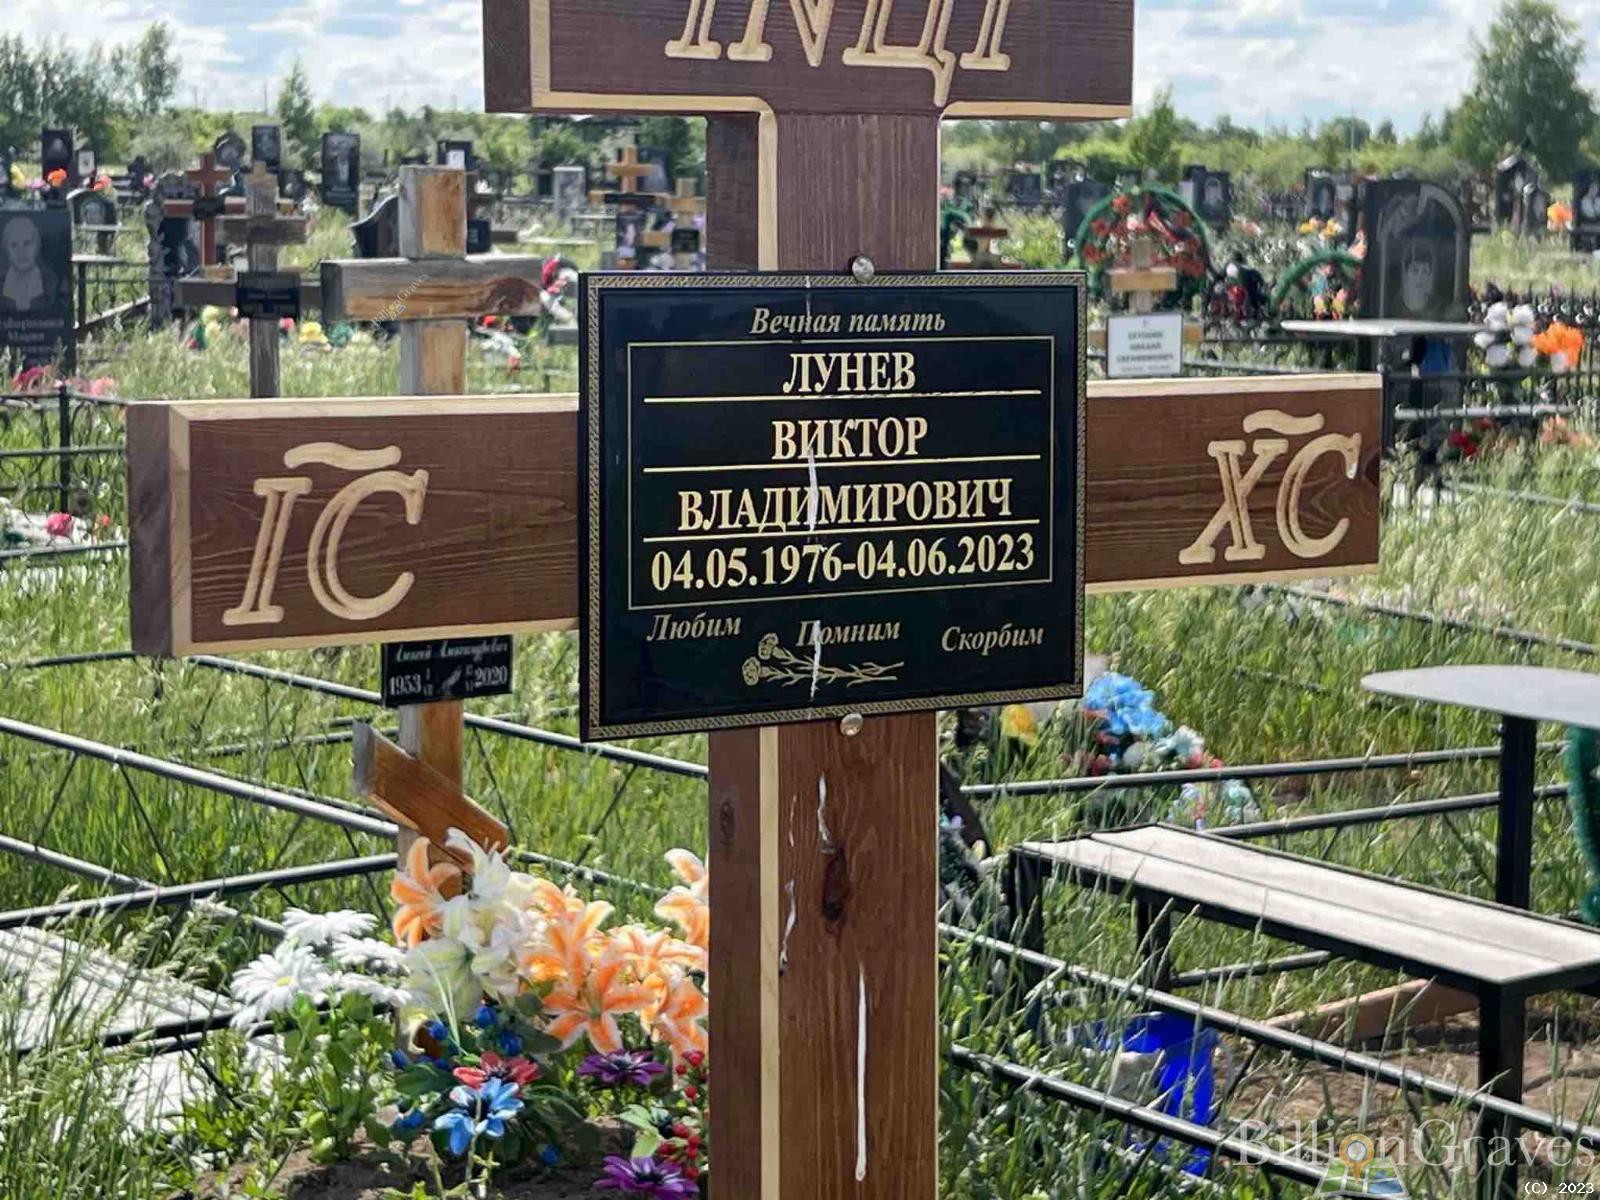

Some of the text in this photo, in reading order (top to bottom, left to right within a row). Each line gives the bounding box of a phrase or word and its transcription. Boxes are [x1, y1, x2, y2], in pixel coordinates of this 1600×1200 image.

[749, 307, 946, 334] Вечная память
[782, 351, 916, 394] ЛУНЕВ
[771, 416, 928, 460] ВИКТОР
[677, 478, 1013, 534] ВЛАДИМИРОВИЧ
[650, 532, 1035, 592] 04.05.1976-04.06.2023
[646, 613, 1044, 656] Любим Помним Скорбим
[389, 673, 422, 696] 1953
[474, 664, 508, 688] 2020
